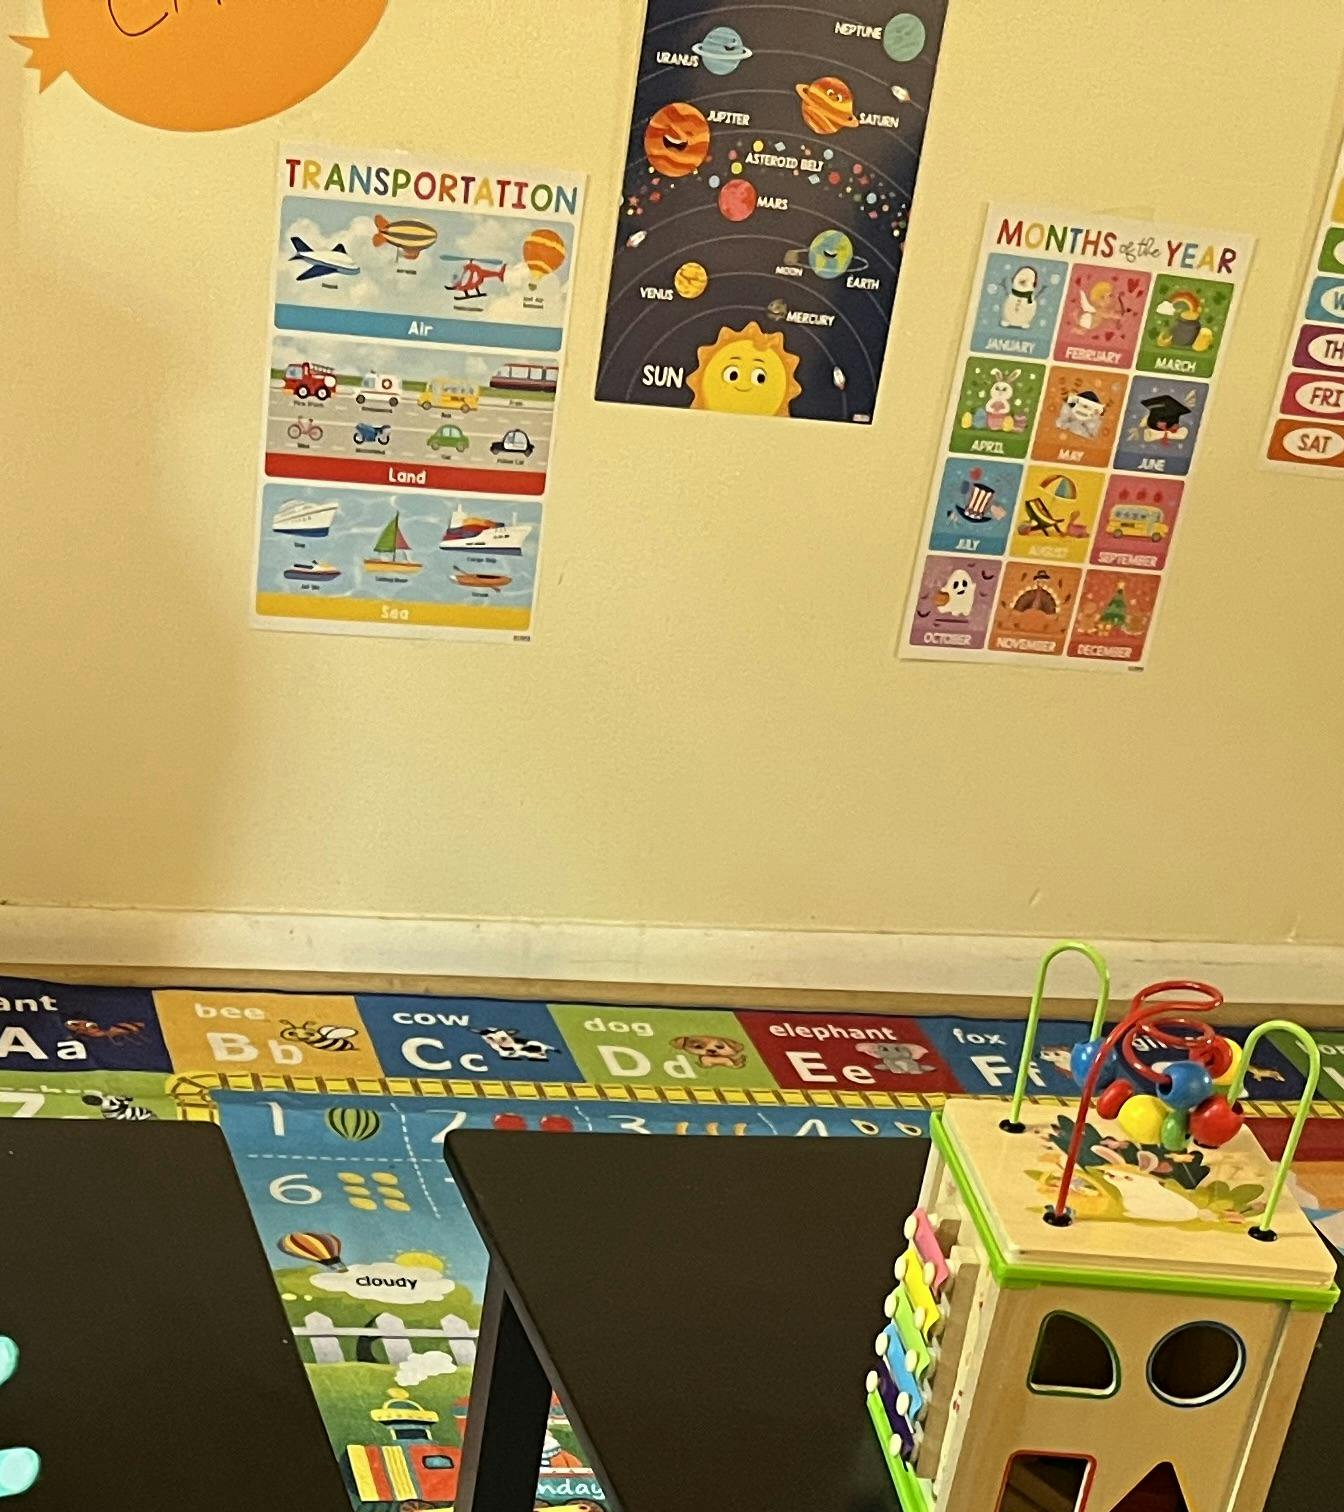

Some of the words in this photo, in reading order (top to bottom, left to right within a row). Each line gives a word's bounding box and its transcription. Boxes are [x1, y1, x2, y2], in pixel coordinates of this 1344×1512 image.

[834, 22, 882, 40] NEPTUNE
[656, 52, 698, 68] URANUS
[707, 110, 750, 126] JUPITER
[859, 113, 898, 128] SATURN
[745, 152, 798, 169] ASTEROID
[800, 158, 824, 172] BELT
[286, 159, 577, 214] TRANSPORTATION
[757, 197, 788, 210] MARS
[996, 218, 1117, 259] MONTHS
[1136, 238, 1161, 260] the
[1166, 240, 1237, 274] YEAR
[846, 277, 879, 290] EARTH
[640, 288, 673, 300] VENUS
[786, 311, 834, 327] MERCURY
[408, 321, 433, 336] Air
[984, 338, 1035, 355] JANUARY
[1065, 346, 1121, 364] FEBRUARY
[1155, 357, 1197, 374] MARCH
[642, 365, 684, 388] SUN
[1310, 386, 1344, 407] FRI
[971, 439, 1004, 455] APRIL
[1297, 434, 1332, 454] SAT
[1137, 458, 1165, 472] JUNE
[389, 467, 426, 484] Land
[955, 537, 980, 552] JULY
[1098, 551, 1157, 568] SEPTEMBER
[381, 605, 409, 620] Sea
[923, 632, 971, 646] OCTOBER
[997, 637, 1056, 652] NOVEMBER
[194, 1002, 265, 1021] bee
[393, 1011, 469, 1027] cow
[583, 1018, 654, 1038] dog
[769, 1021, 900, 1042] elephant
[952, 1028, 1007, 1046] fox
[269, 1174, 322, 1205] 6
[355, 1273, 418, 1291] cloudy
